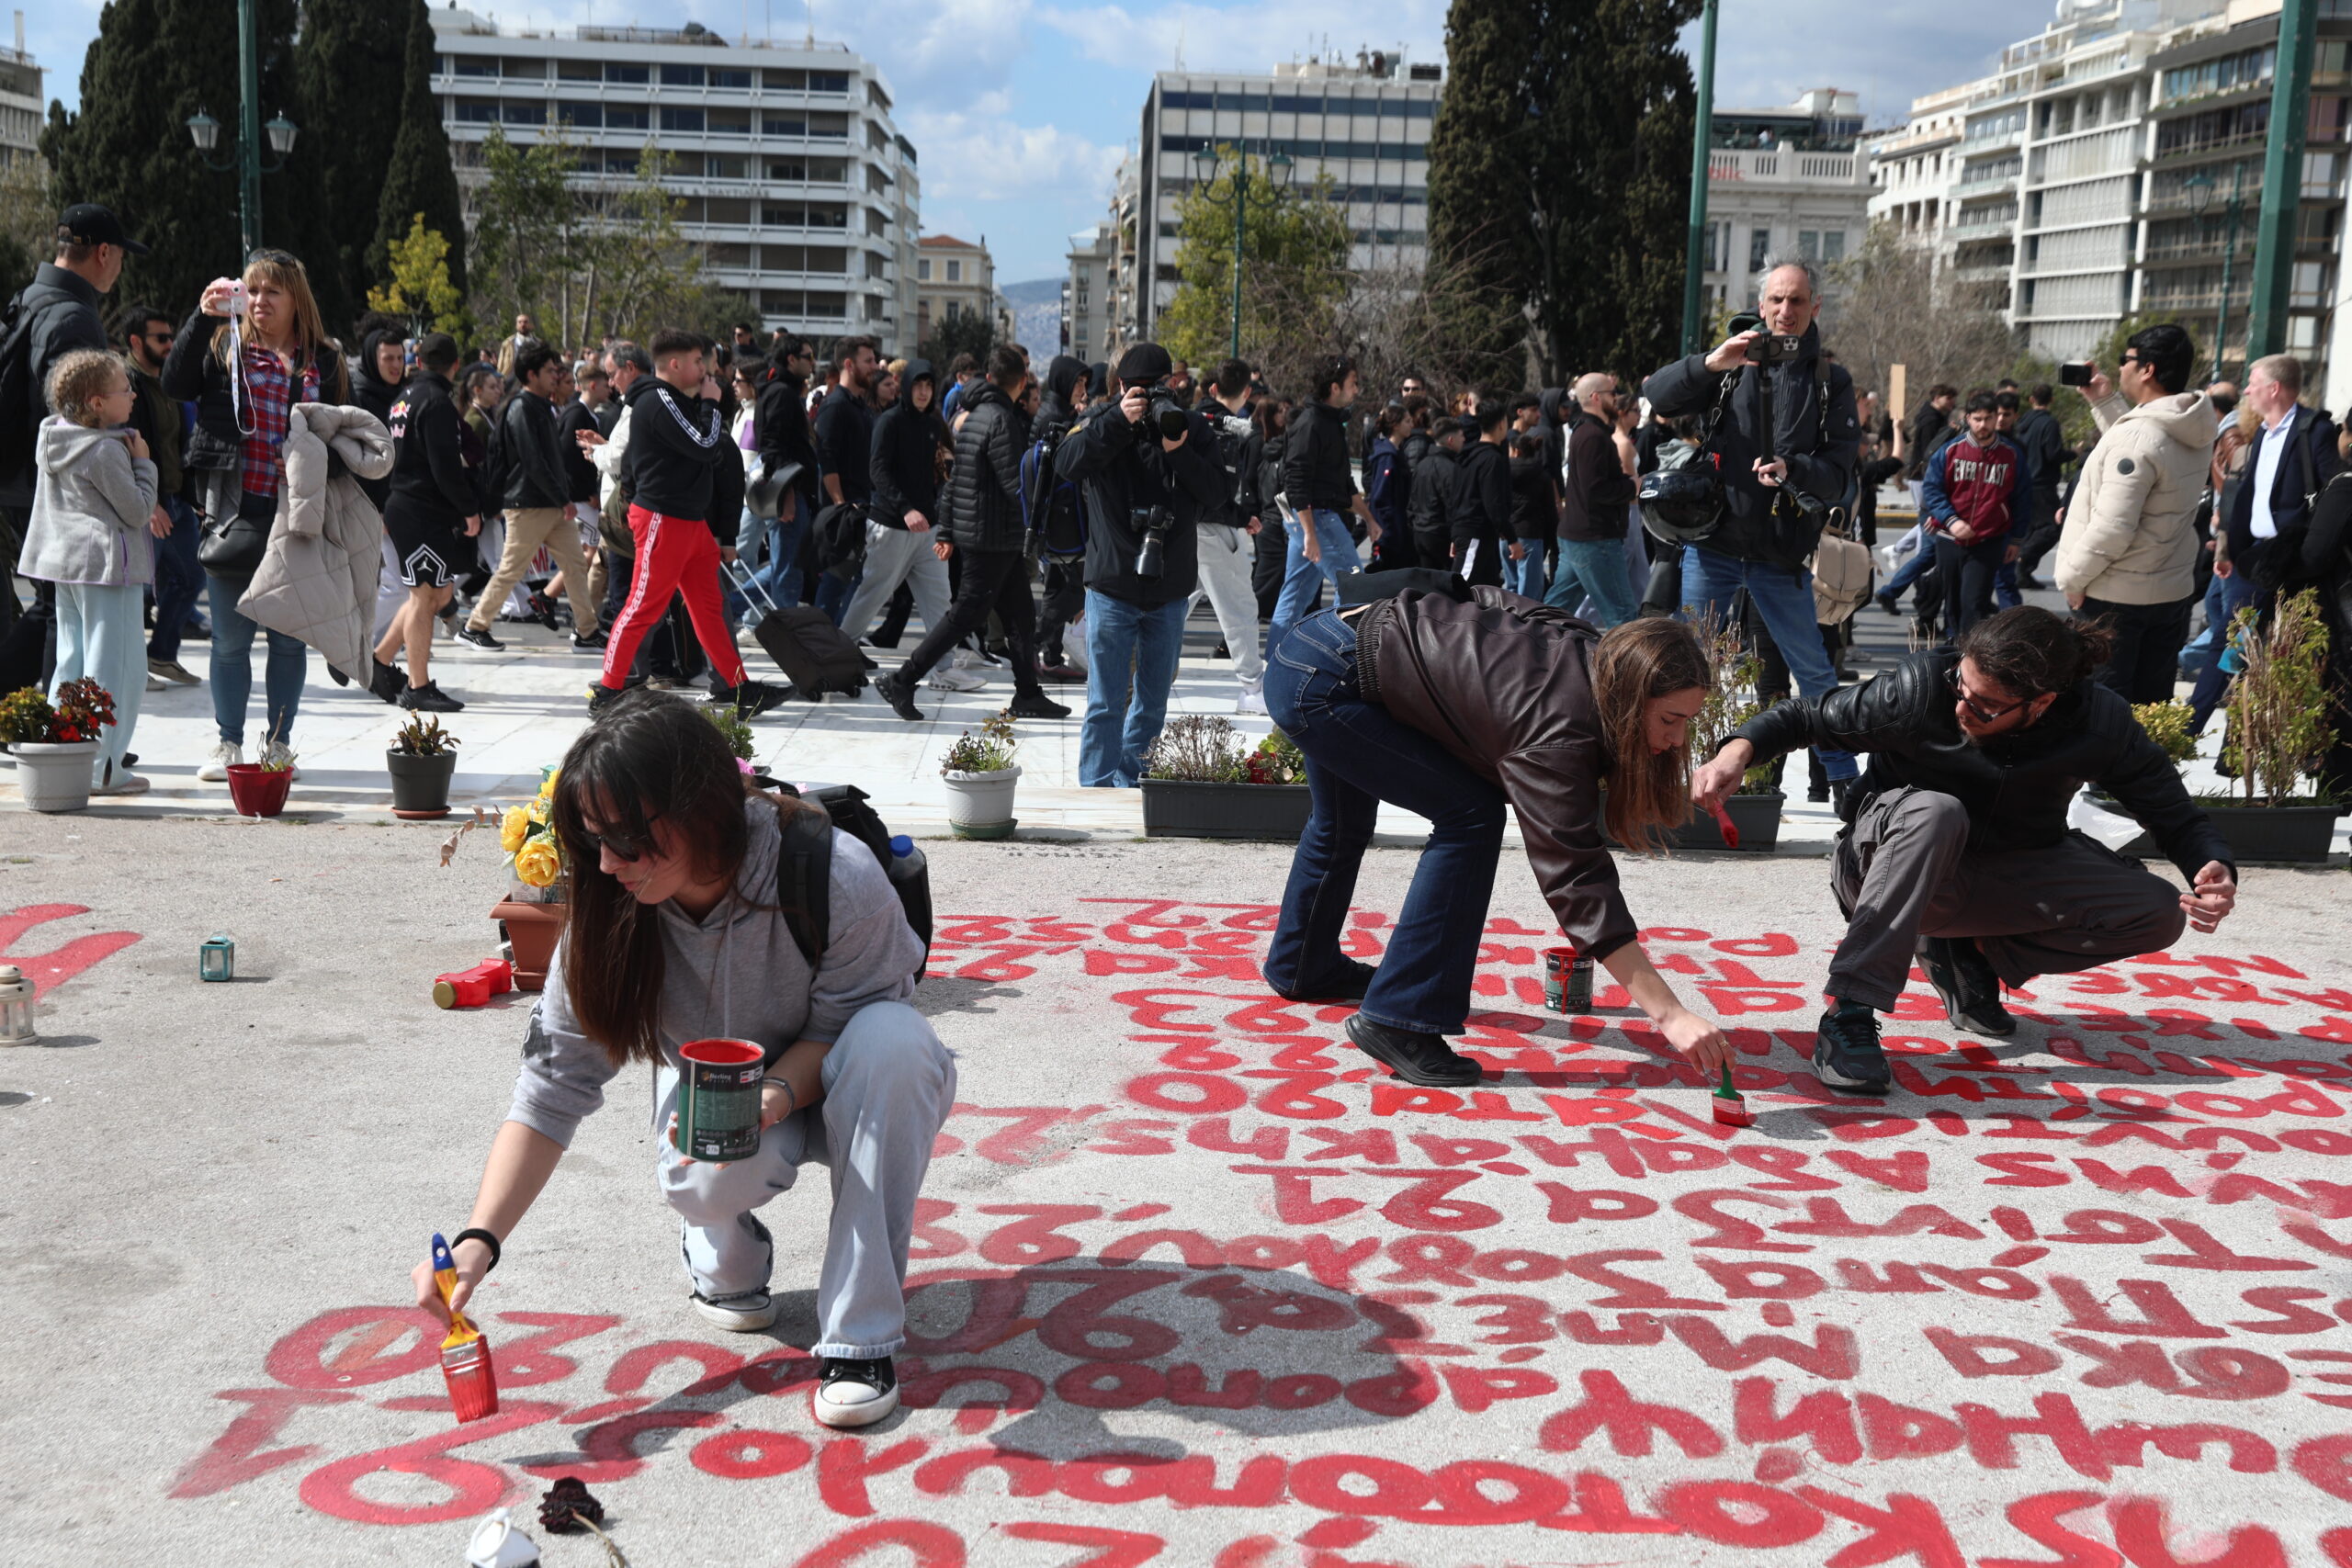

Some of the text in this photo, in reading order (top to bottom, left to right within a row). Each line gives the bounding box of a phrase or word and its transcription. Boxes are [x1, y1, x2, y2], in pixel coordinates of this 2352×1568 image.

[1111, 988, 1308, 1033] 23
[1128, 1033, 1339, 1070] 22
[1125, 1070, 1348, 1120] 20
[1231, 1165, 1502, 1232] 21
[903, 1269, 1178, 1359] 20
[175, 1388, 568, 1525] 21
